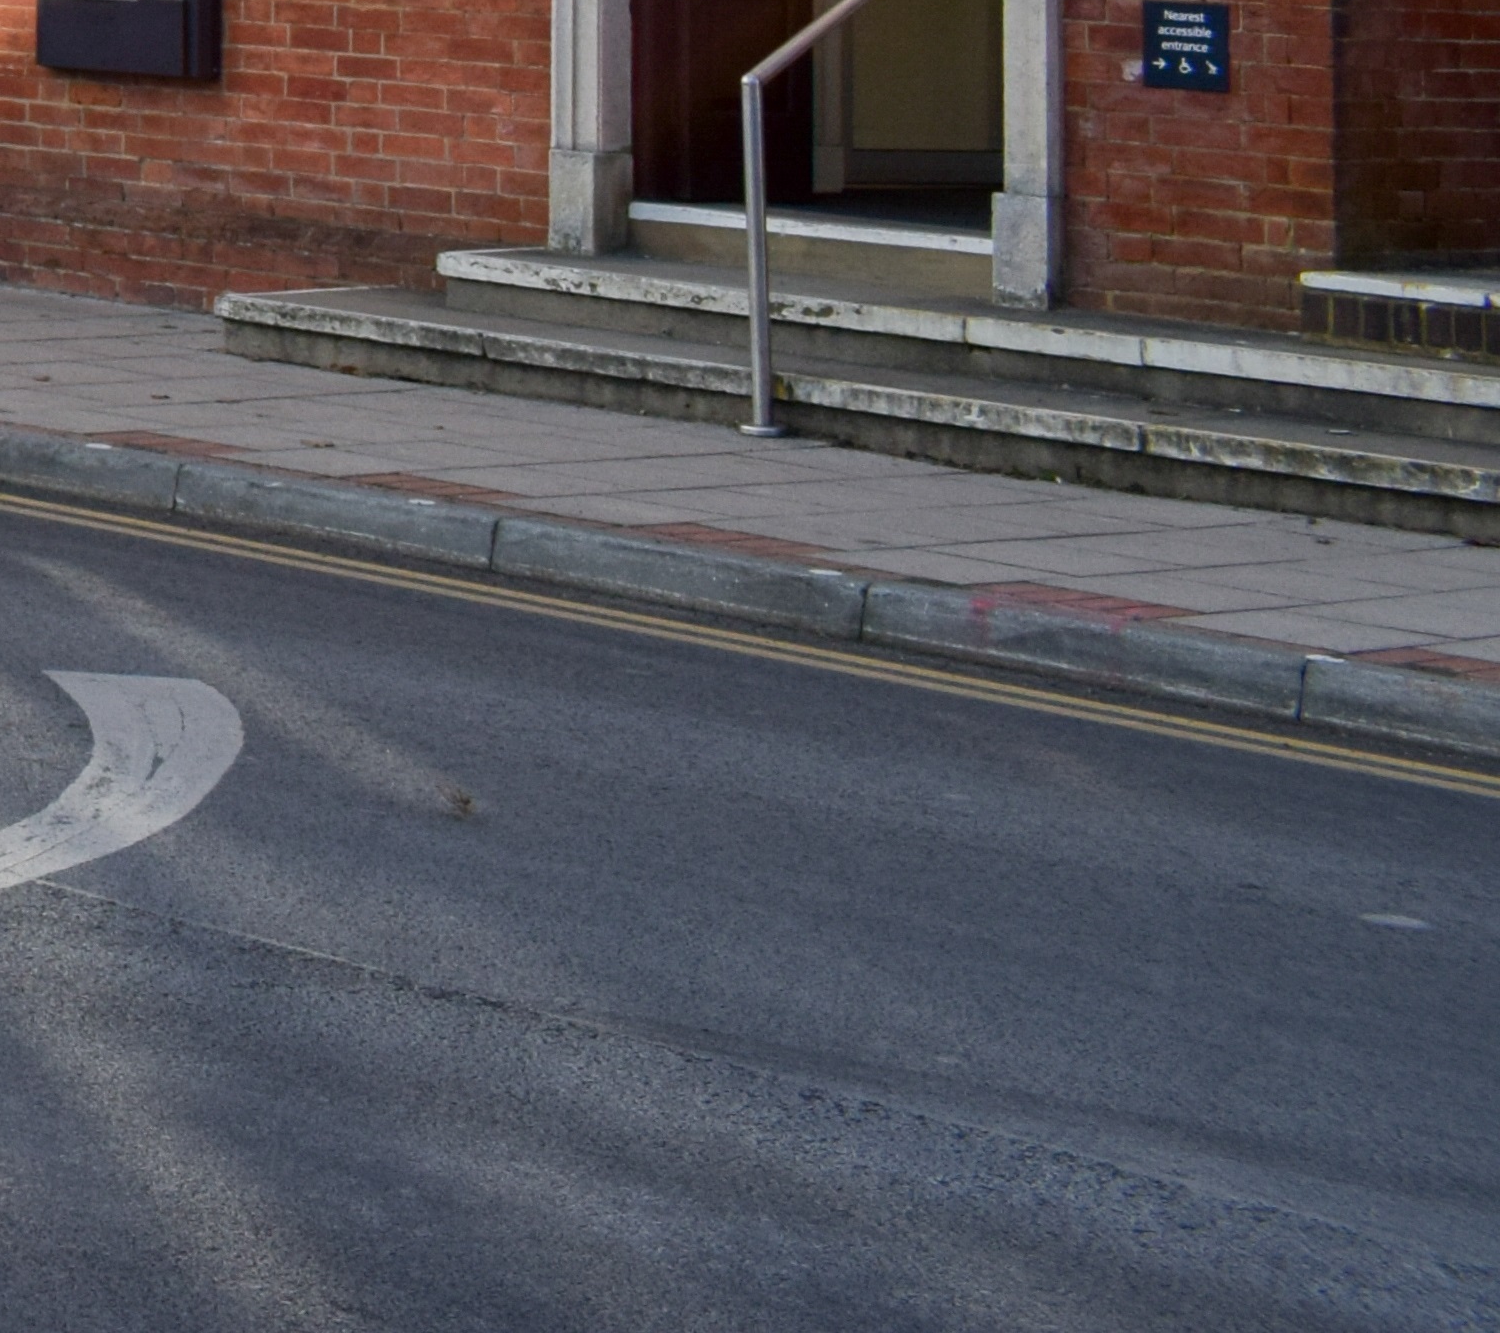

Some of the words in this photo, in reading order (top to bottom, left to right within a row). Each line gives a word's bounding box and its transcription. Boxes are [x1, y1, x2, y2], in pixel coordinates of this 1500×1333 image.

[1163, 10, 1205, 22] Nearest
[1158, 26, 1212, 38] accessible
[1161, 41, 1208, 53] entrance
